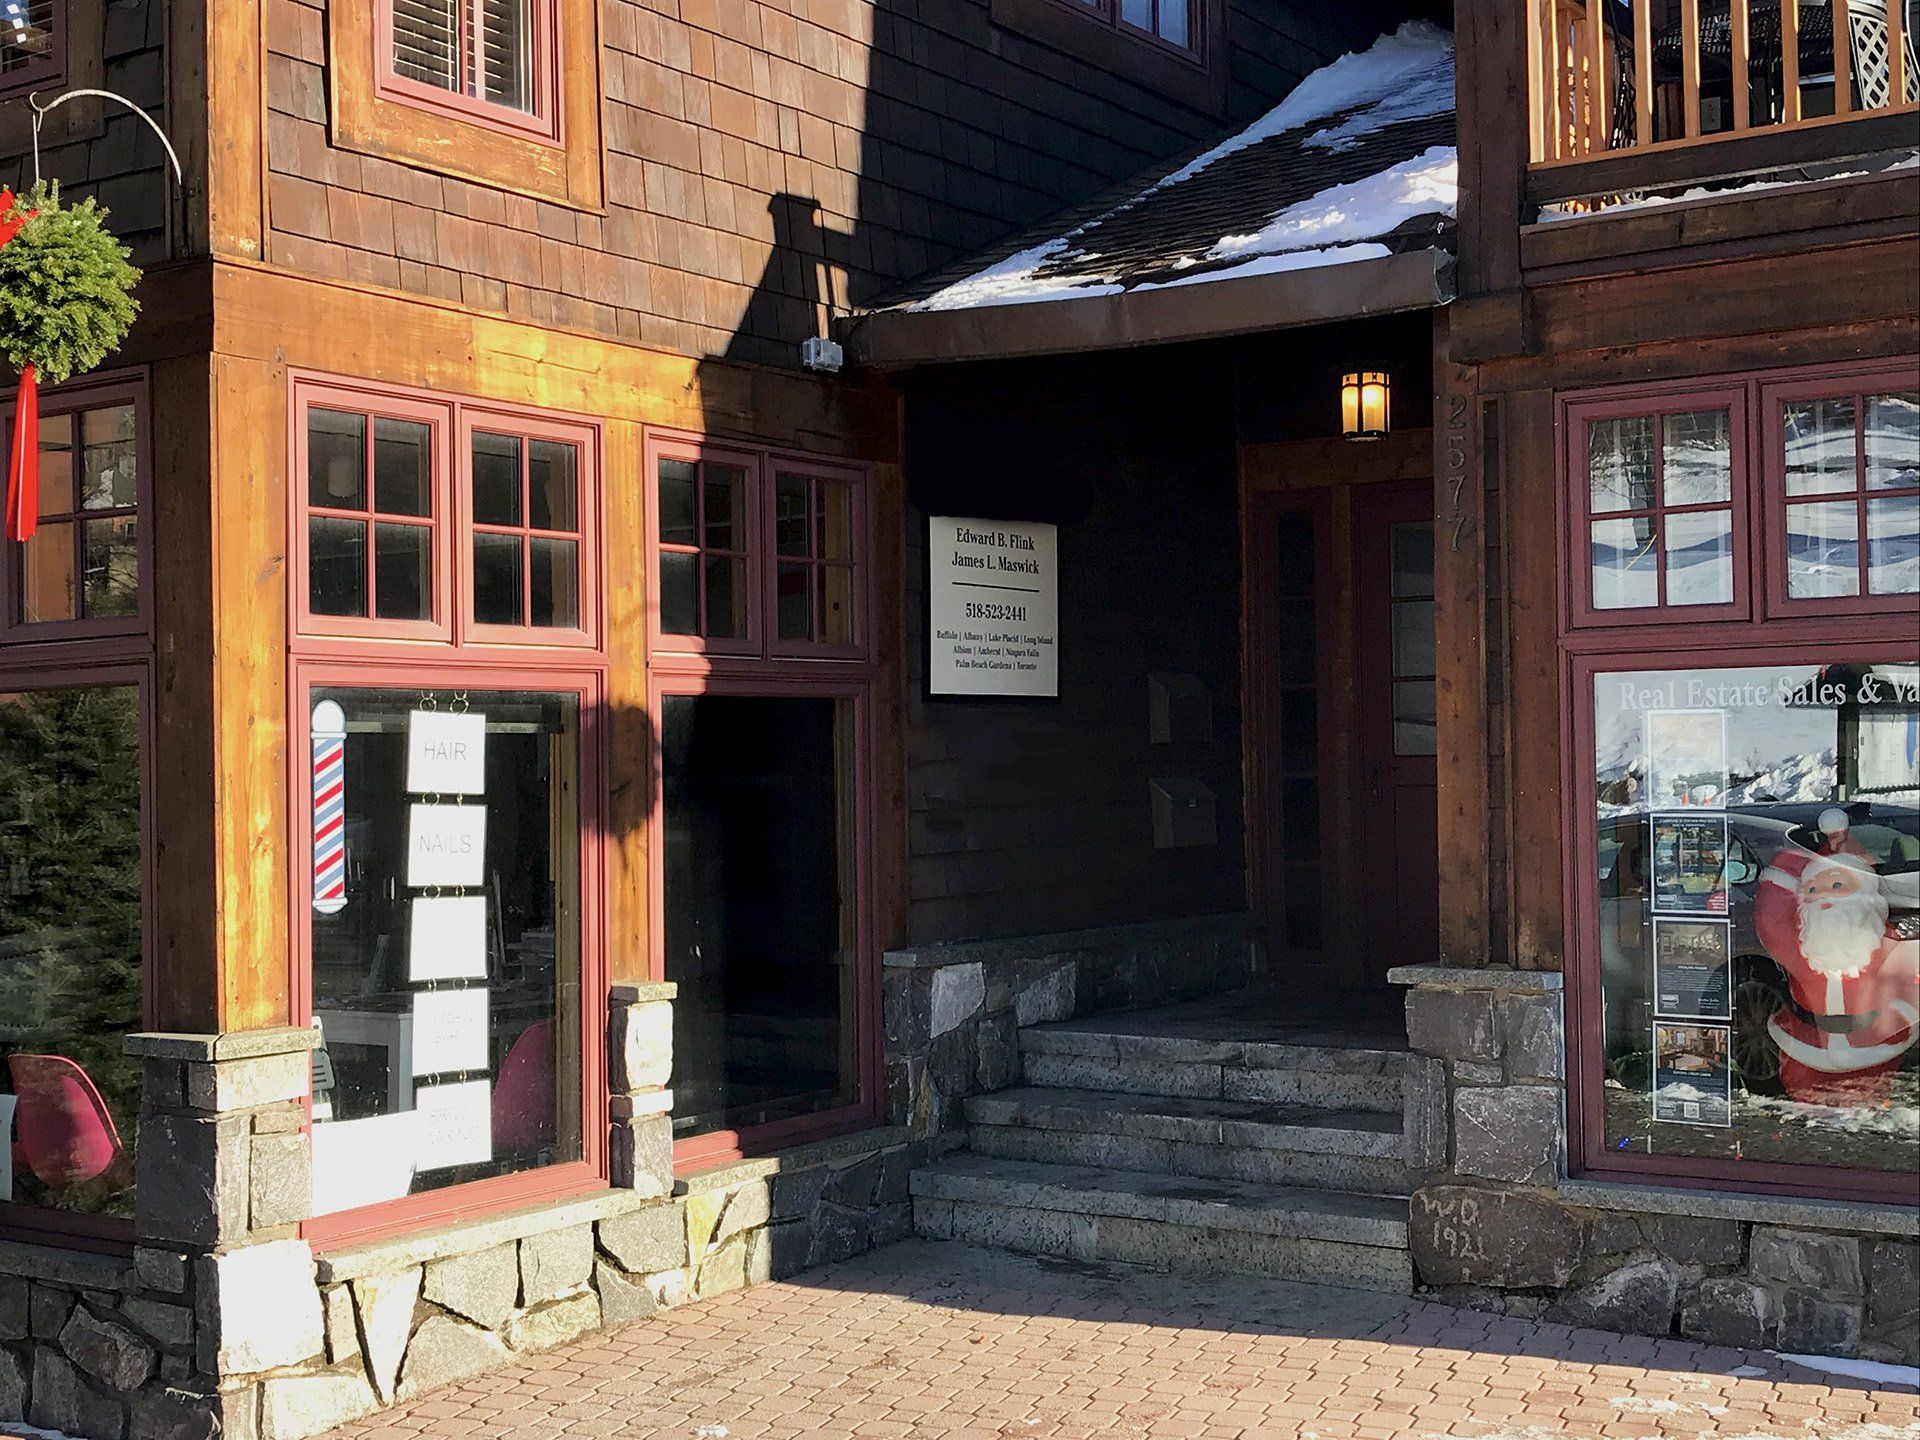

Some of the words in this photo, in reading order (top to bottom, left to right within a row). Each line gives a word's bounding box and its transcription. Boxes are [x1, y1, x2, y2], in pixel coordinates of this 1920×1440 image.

[1448, 395, 1467, 551] 2577
[956, 527, 995, 546] Edward
[998, 532, 1008, 548] B.
[1010, 534, 1035, 551] Flink
[952, 551, 985, 569] James
[987, 555, 996, 570] L.
[998, 556, 1040, 574] Maswick
[966, 602, 1027, 621] 518-523-2441
[1618, 681, 1676, 711] Real
[1687, 678, 1769, 709] Estate
[1777, 674, 1846, 707] Sales
[1856, 673, 1883, 704] &
[424, 741, 467, 760] HAIR
[419, 834, 472, 854] NAILS
